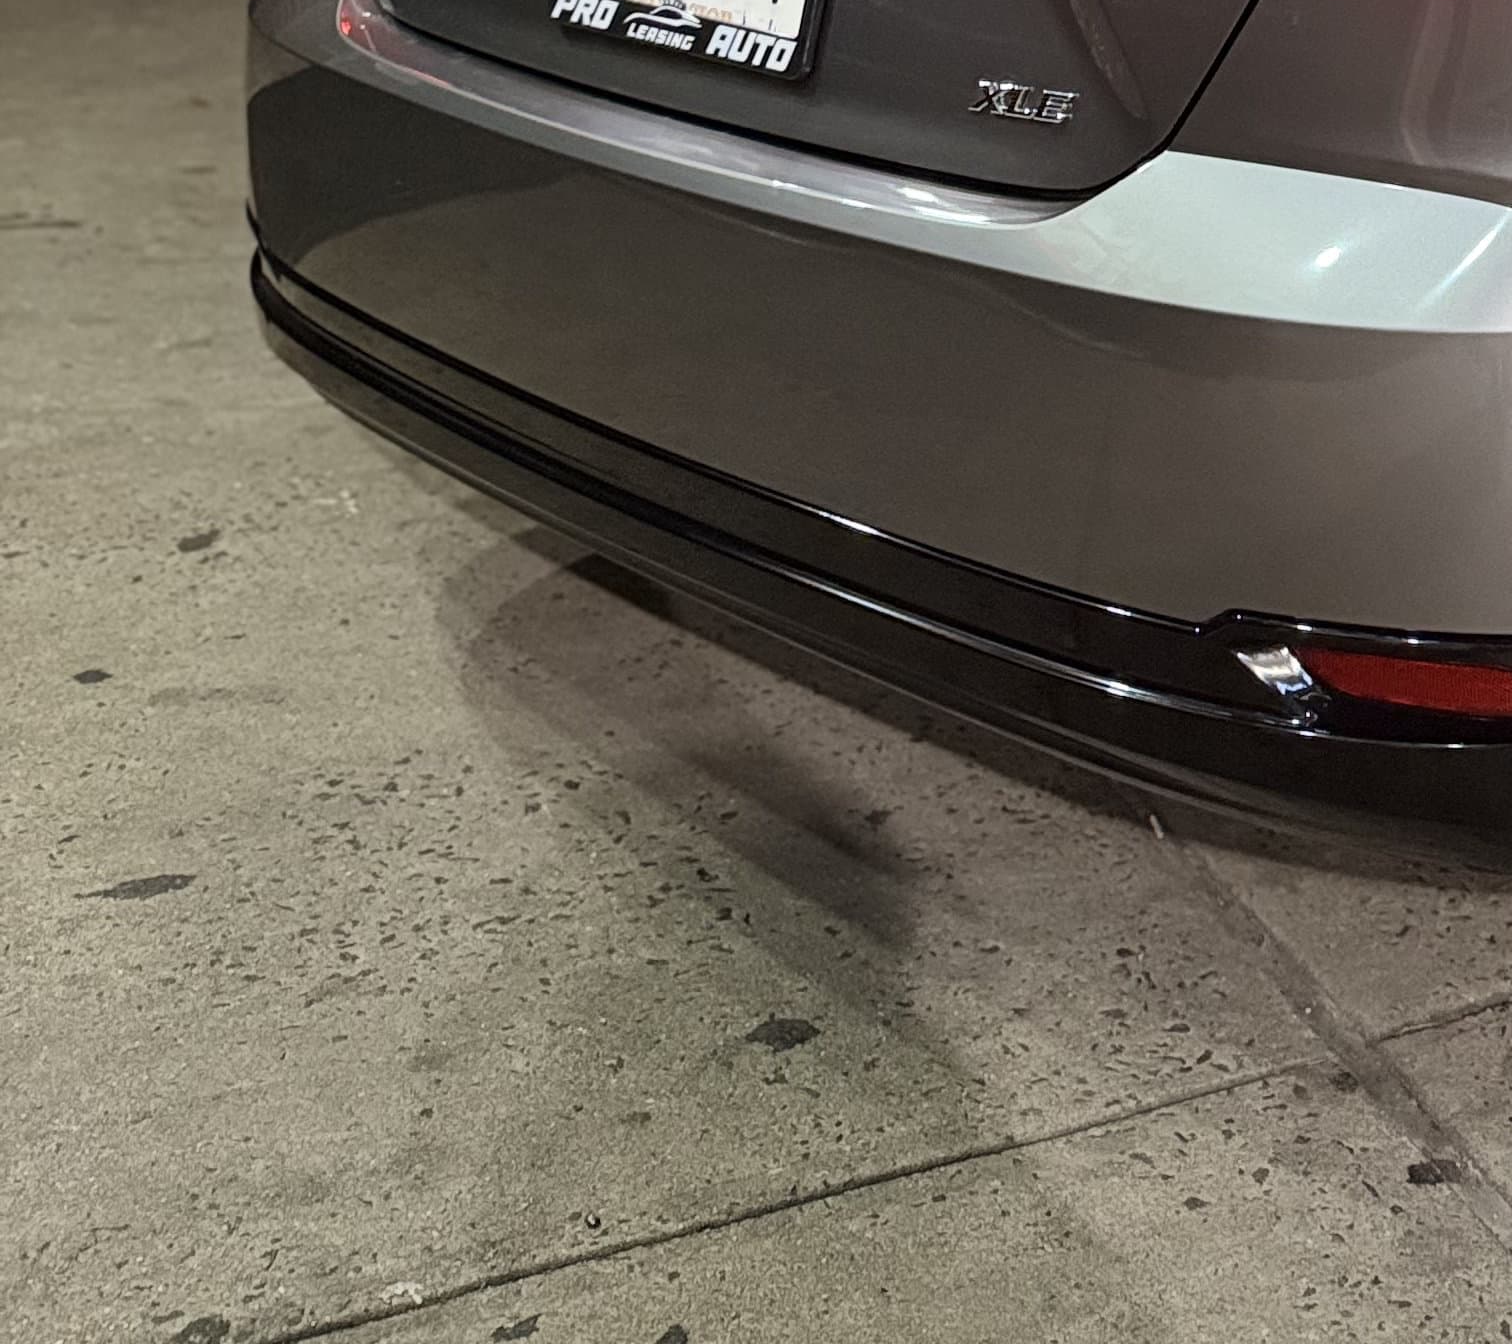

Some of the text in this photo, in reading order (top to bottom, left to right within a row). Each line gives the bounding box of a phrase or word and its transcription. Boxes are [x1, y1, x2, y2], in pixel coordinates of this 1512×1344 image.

[626, 22, 696, 51] LEASING
[705, 24, 798, 72] AUTO
[968, 80, 1079, 124] XLE
